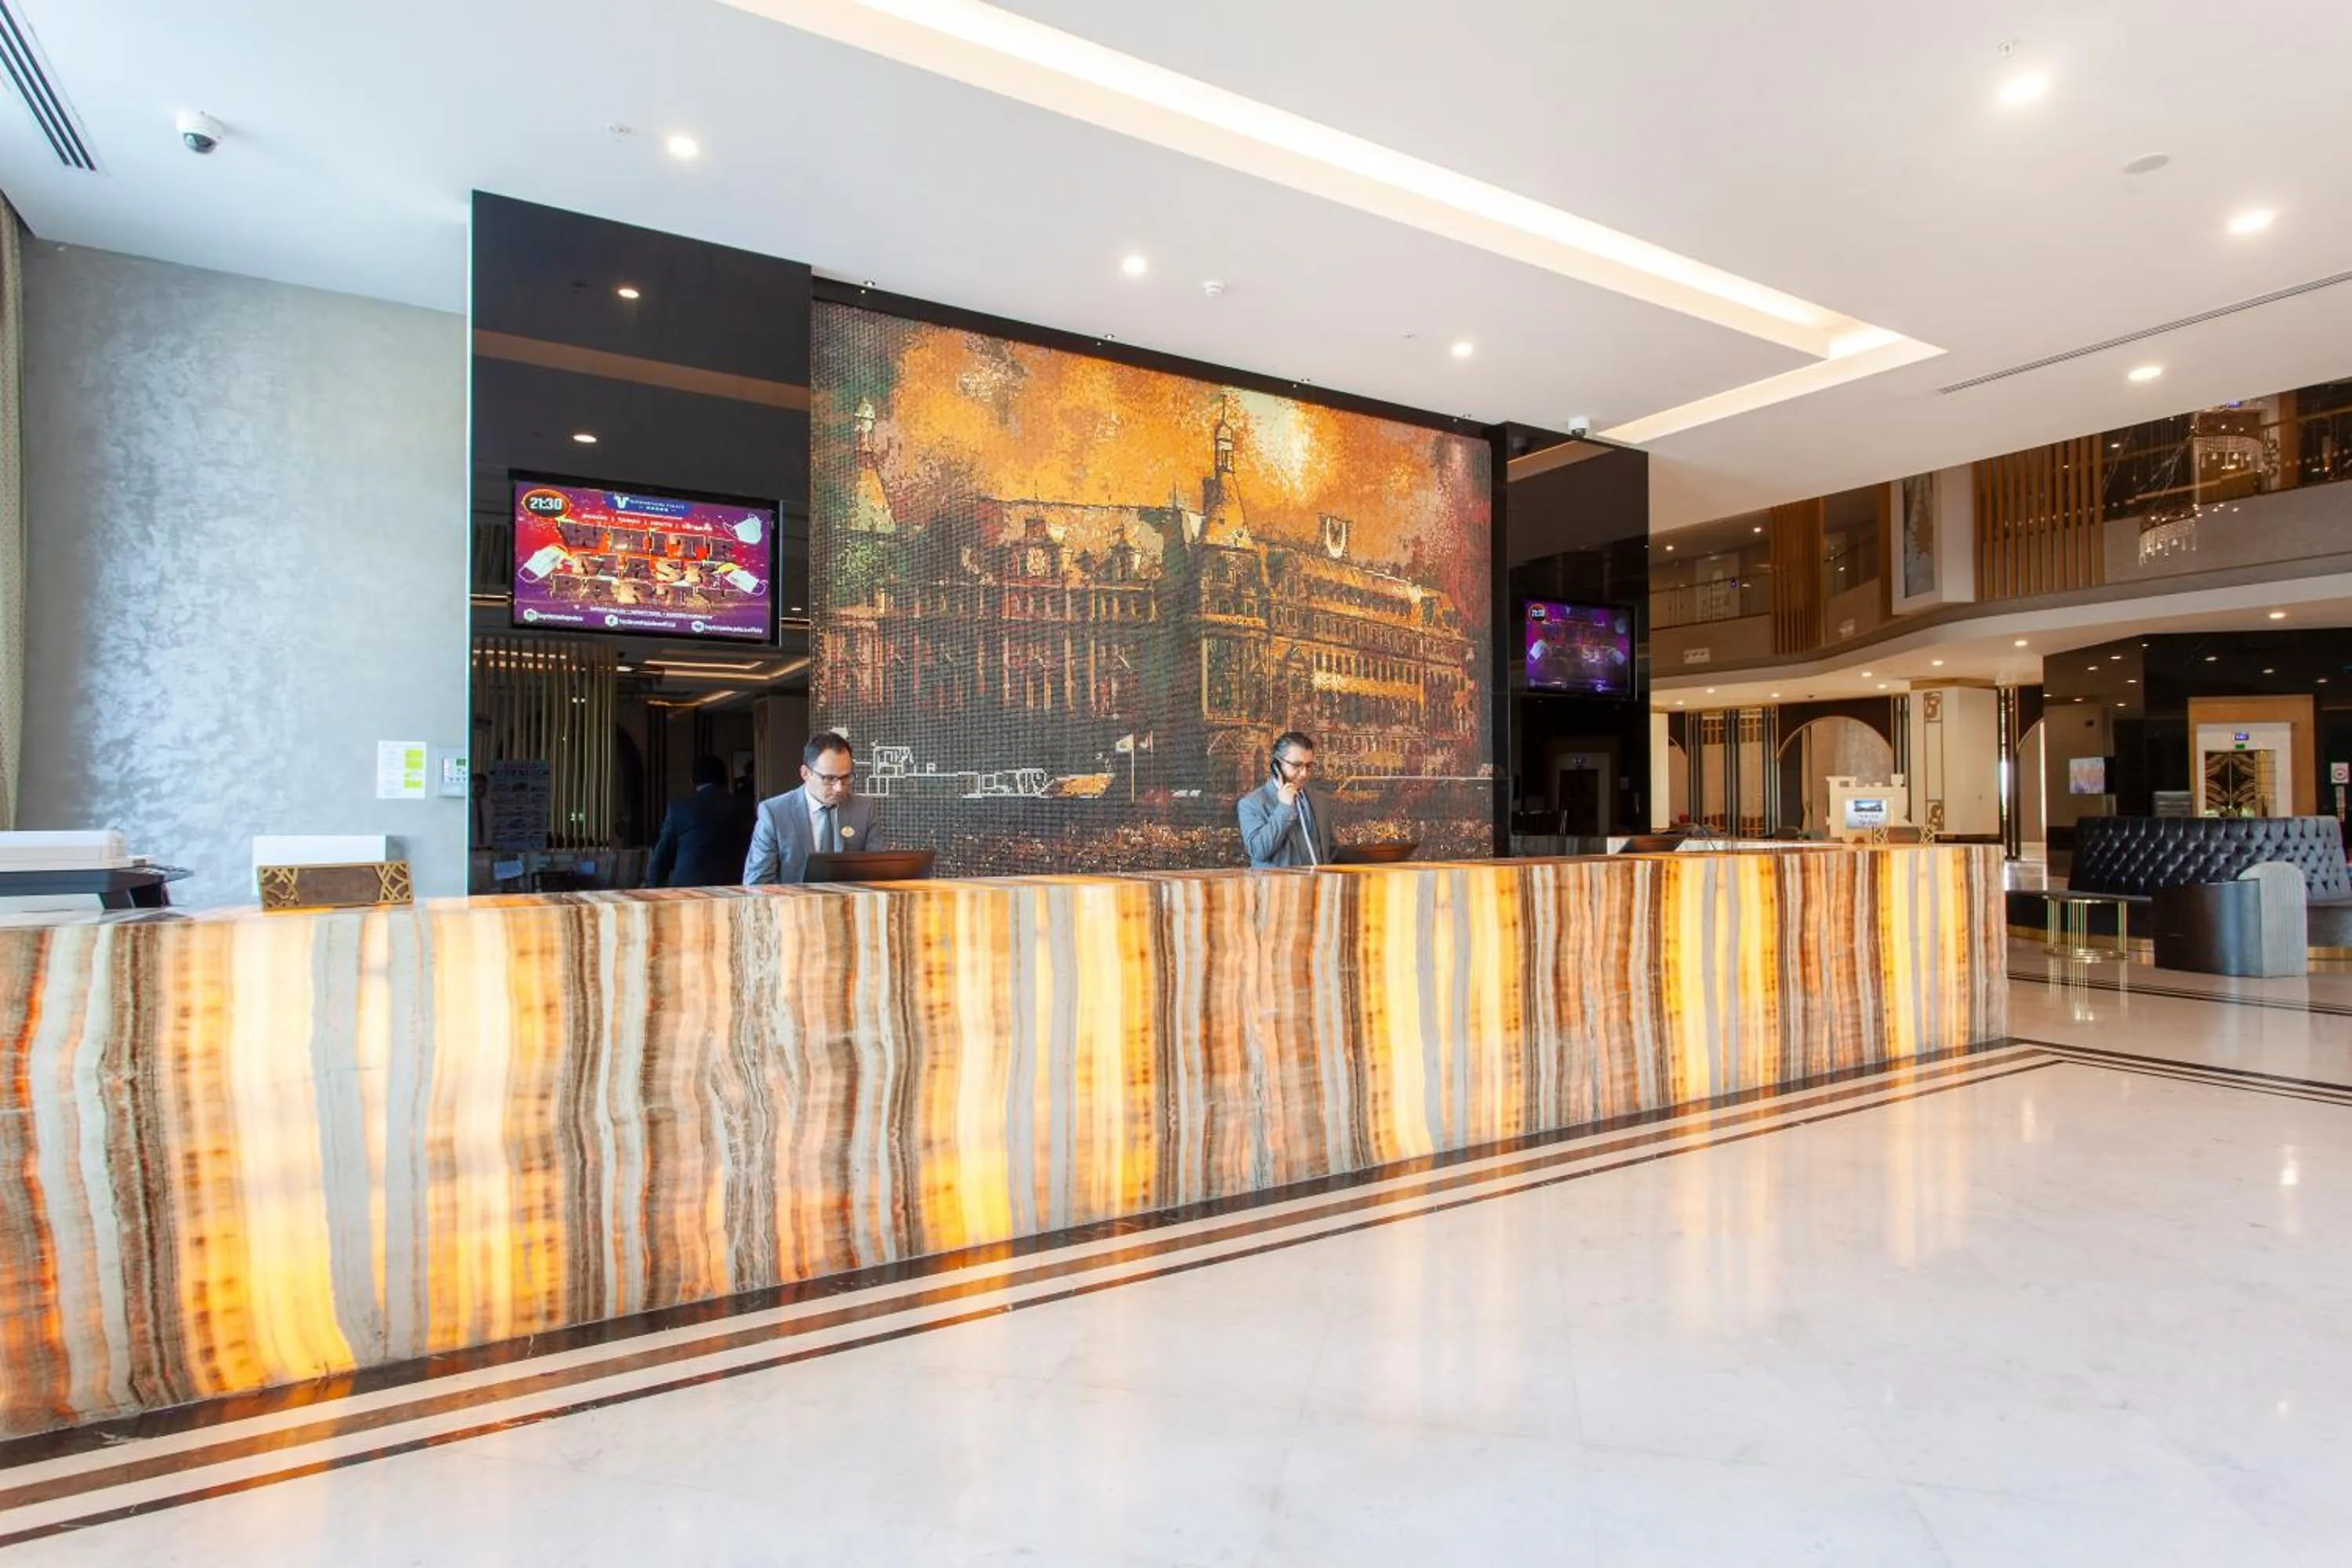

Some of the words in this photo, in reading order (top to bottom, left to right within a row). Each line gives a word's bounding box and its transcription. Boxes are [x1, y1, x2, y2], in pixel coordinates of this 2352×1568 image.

[530, 496, 562, 510] 21:30
[557, 519, 735, 561] WHITE
[571, 550, 723, 587] MASK
[550, 573, 742, 609] PARTY
